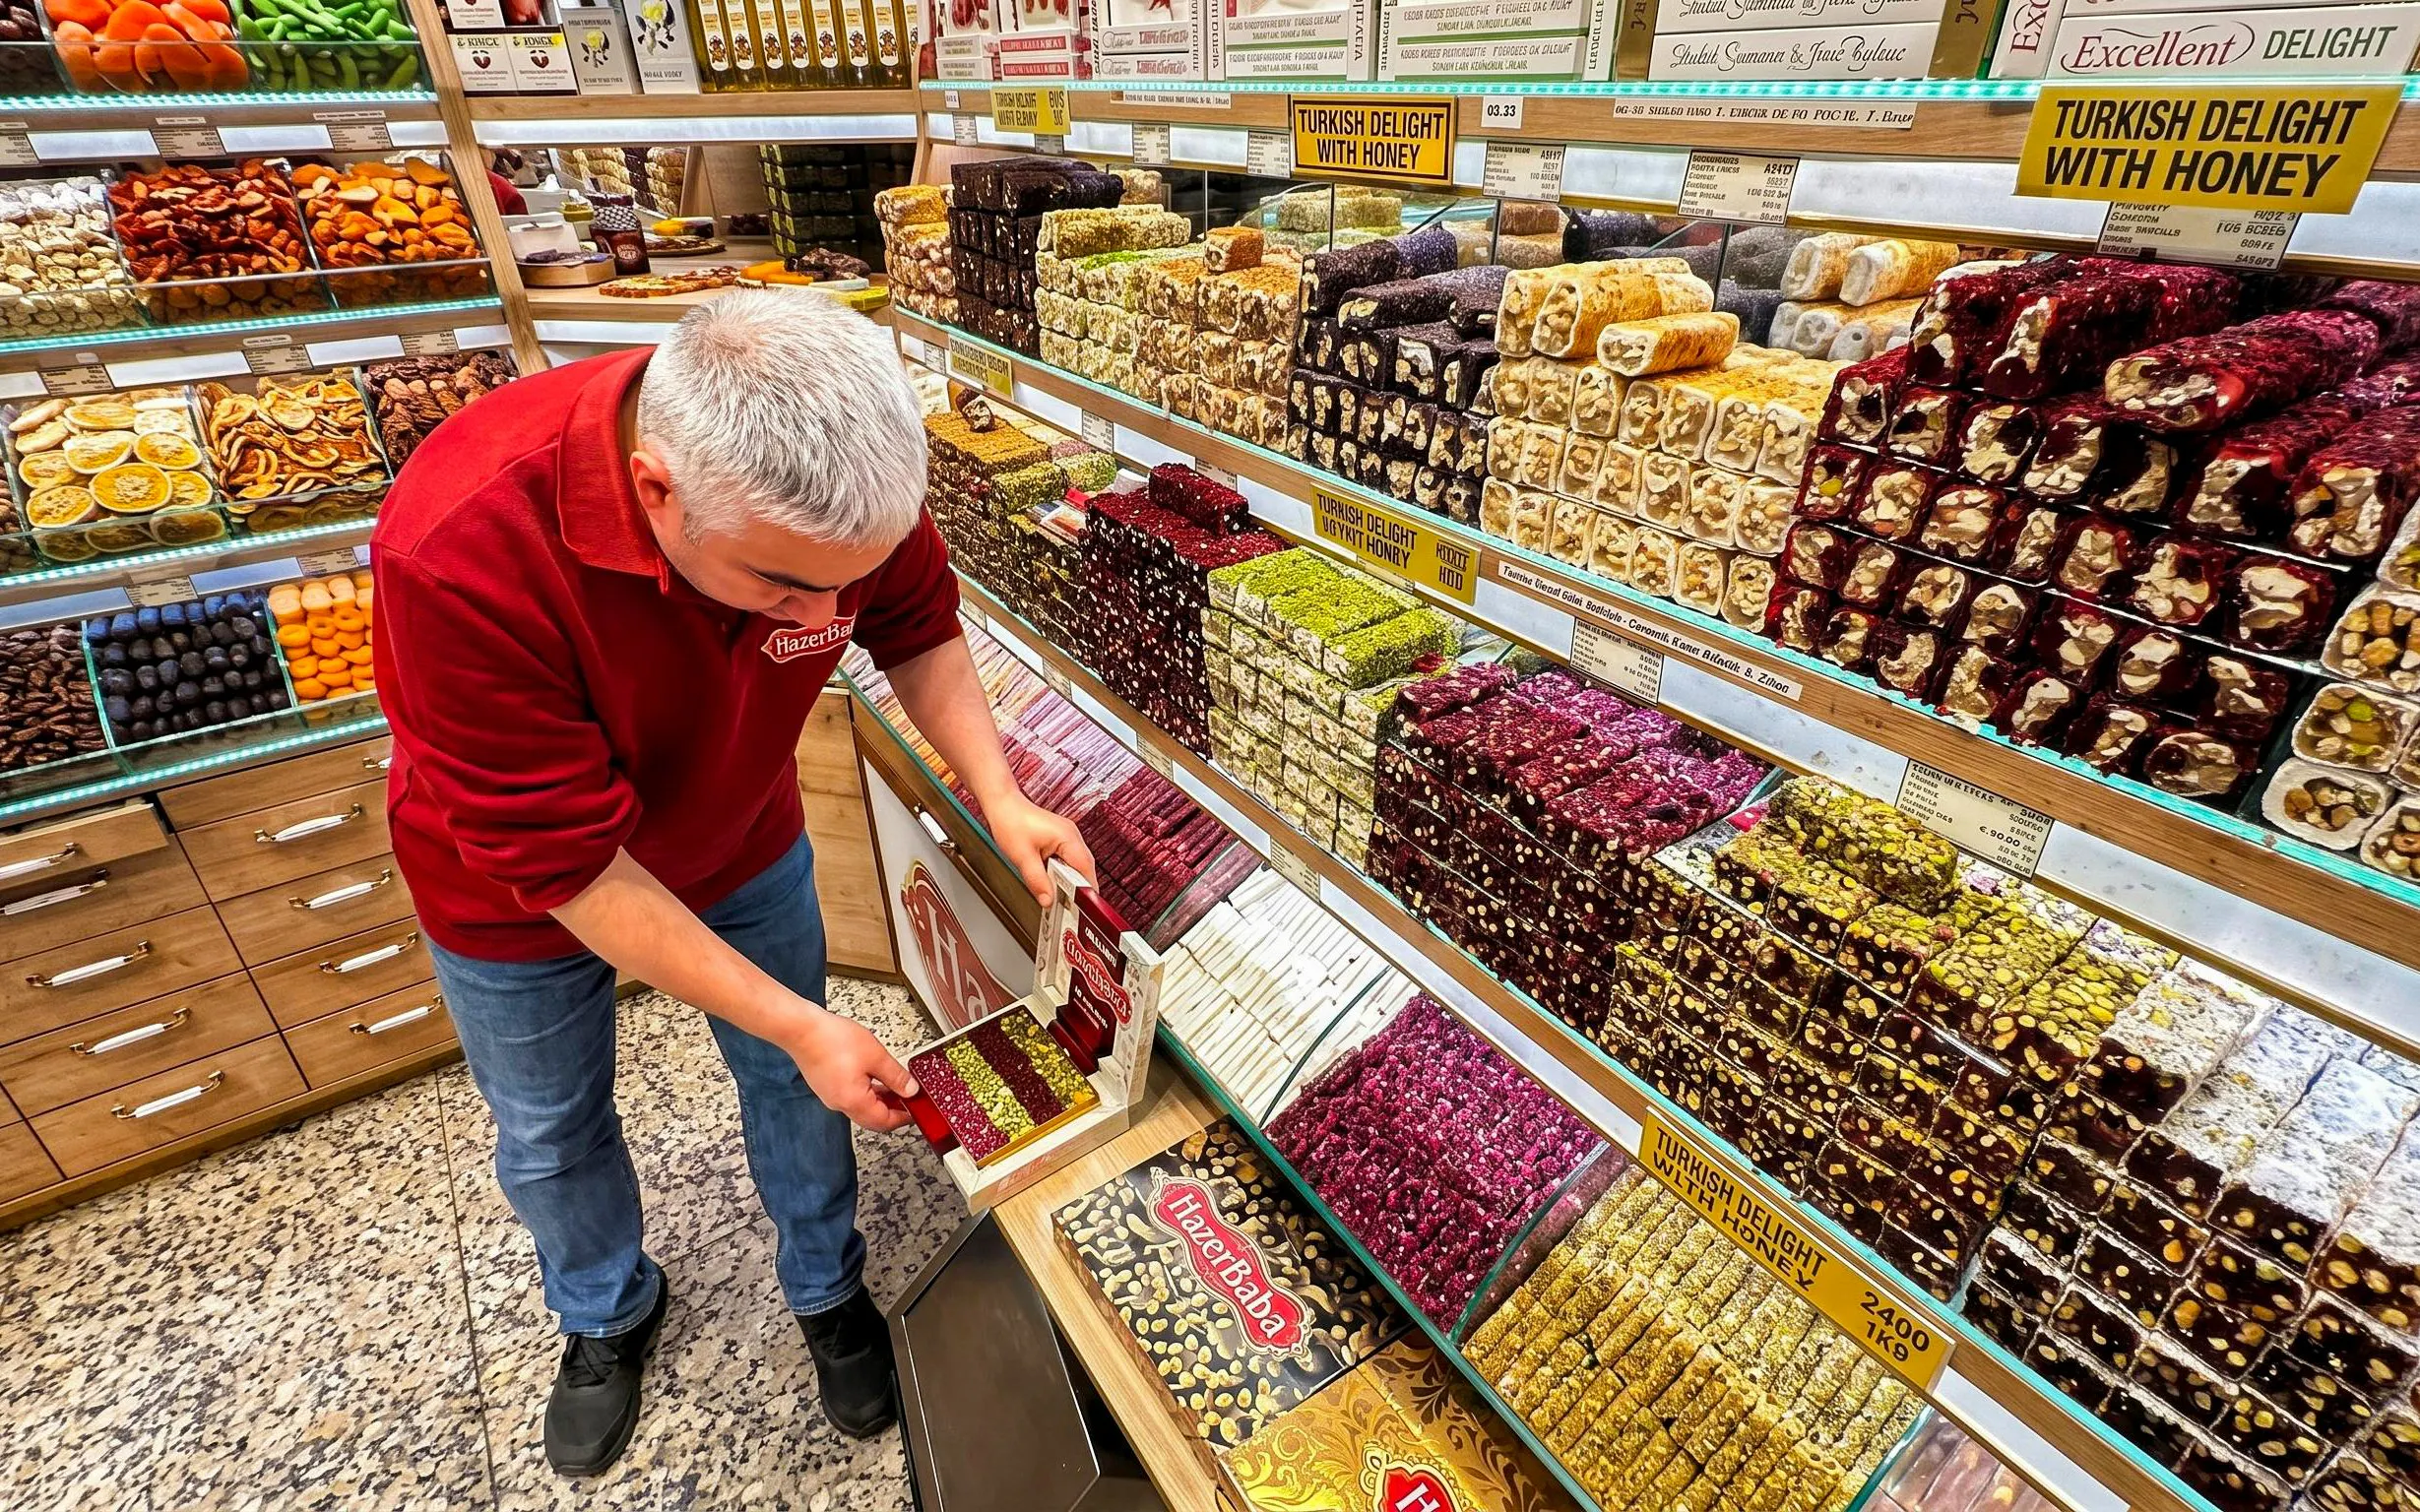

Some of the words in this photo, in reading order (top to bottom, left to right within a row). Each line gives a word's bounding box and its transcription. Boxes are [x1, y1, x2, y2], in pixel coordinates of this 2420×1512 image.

[2070, 30, 2239, 70] Excellent
[2262, 26, 2398, 60] DELIGHT
[1298, 108, 1367, 137] TURKISH
[1369, 110, 1444, 140] DELIGHT
[1488, 103, 1517, 117] 03.33
[2053, 99, 2197, 142] TURKISH
[2198, 99, 2368, 145] DELIGHT
[1317, 138, 1359, 164] WITH
[1363, 141, 1421, 170] HONEY
[2044, 147, 2158, 190] WITH
[2162, 150, 2340, 197] HONEY
[1316, 494, 1365, 529] TURKISH
[1367, 512, 1417, 551] DELIGHT
[1656, 1126, 1736, 1207] TURKISH
[1736, 1192, 1827, 1278] DELIGHT
[1167, 1192, 1287, 1339] HazerBaba
[1720, 1208, 1815, 1292] HONEY
[1860, 1291, 1931, 1353] 2400
